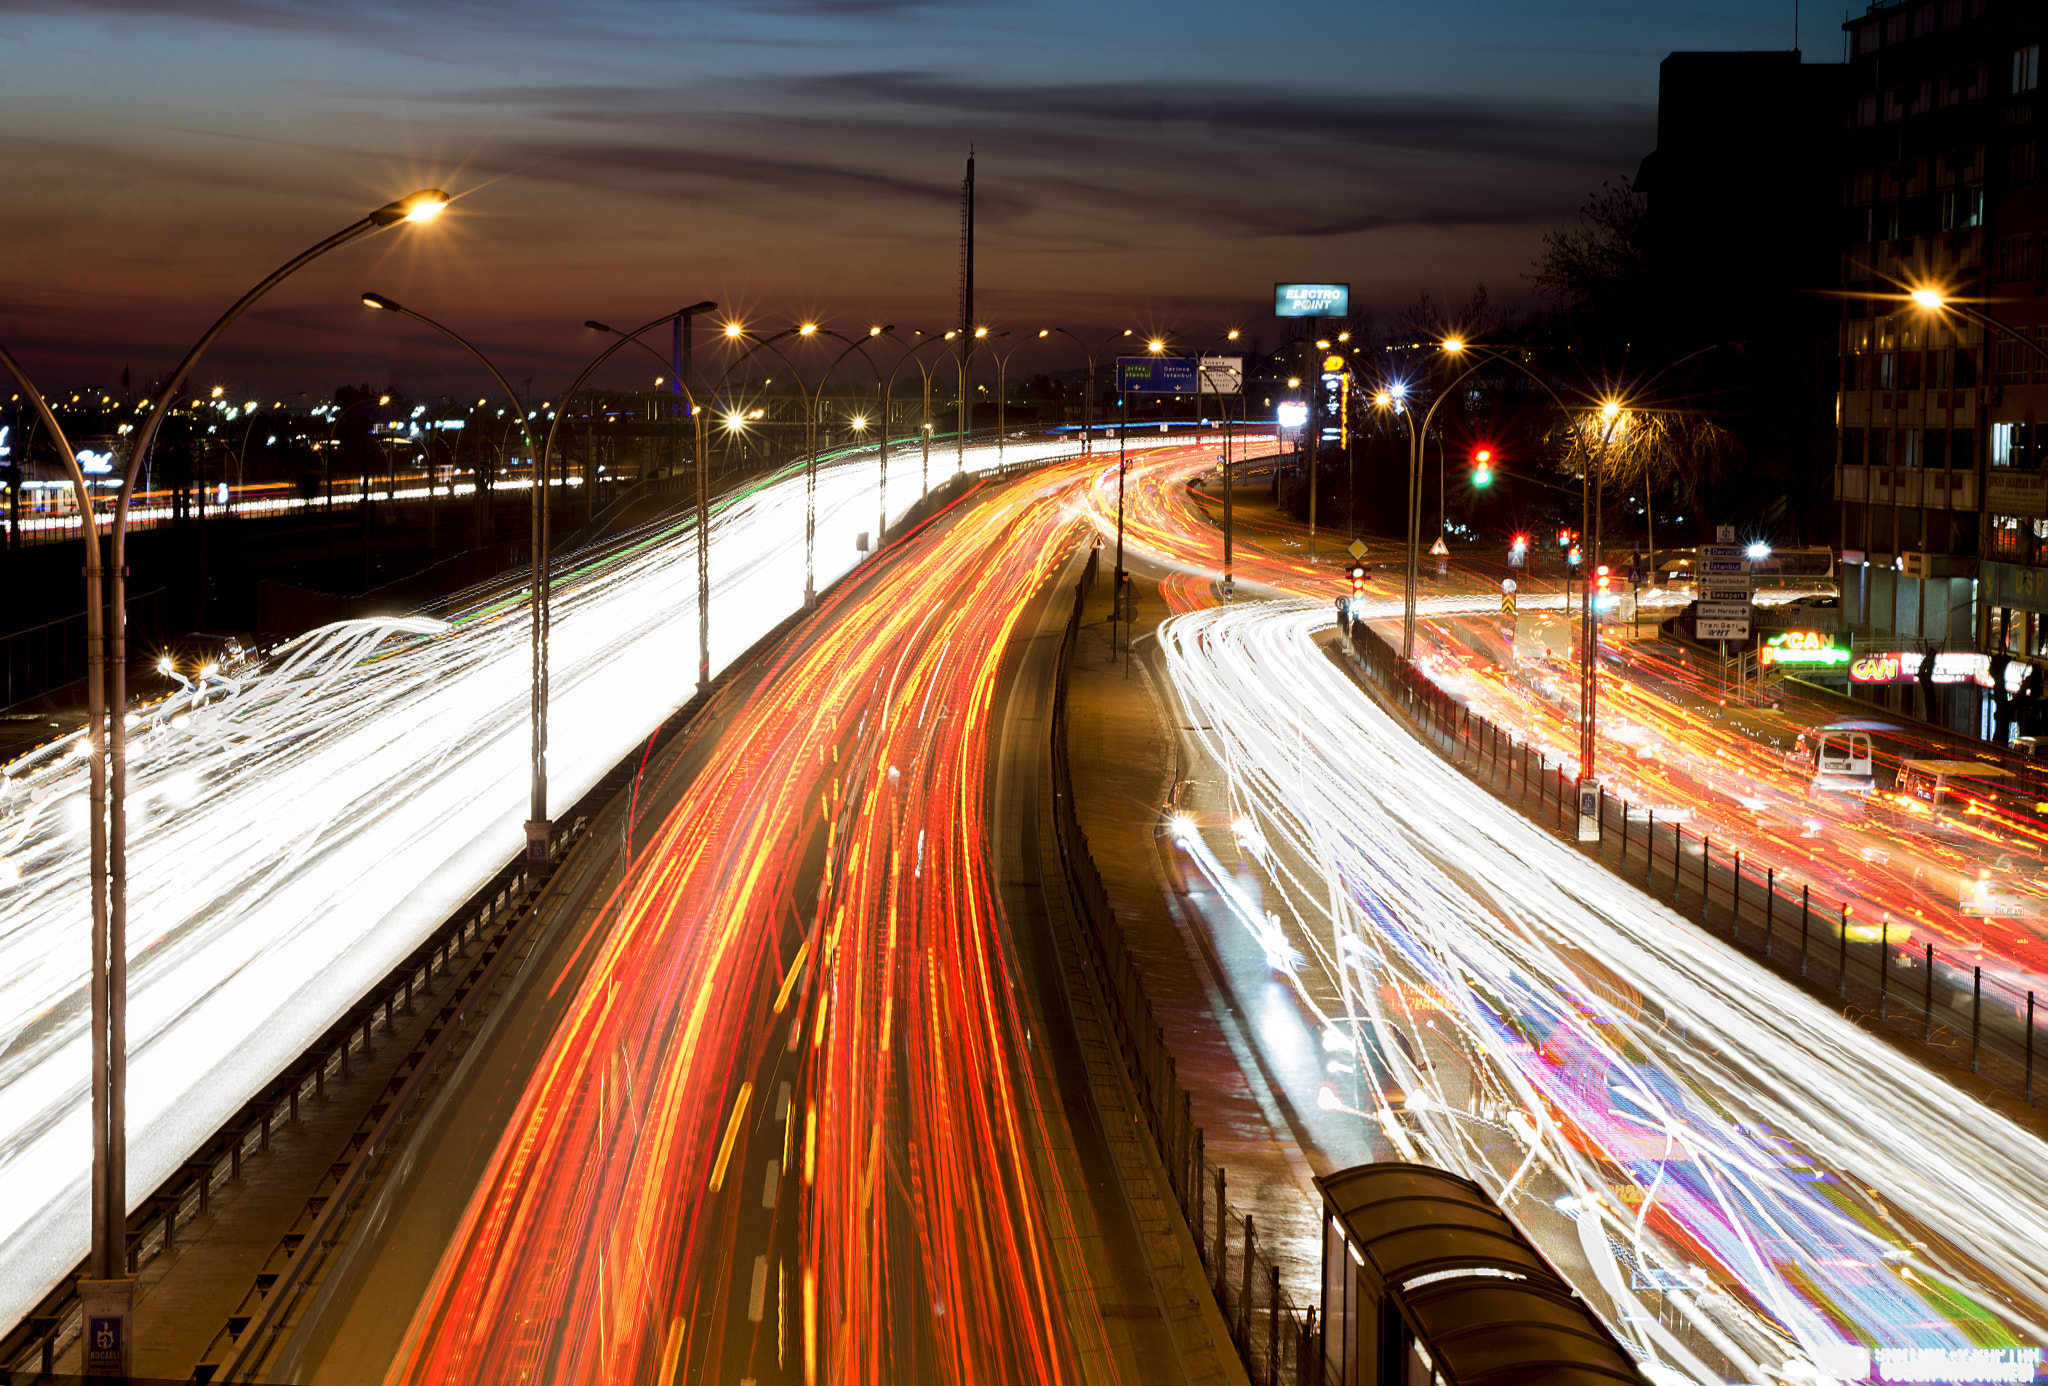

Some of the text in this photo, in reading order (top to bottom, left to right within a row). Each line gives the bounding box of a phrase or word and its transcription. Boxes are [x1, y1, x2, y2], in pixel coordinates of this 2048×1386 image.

[1286, 289, 1341, 300] ELECTRO
[1293, 300, 1332, 310] POINT
[1785, 631, 1835, 650] CAN
[1851, 658, 1899, 681] CAN
